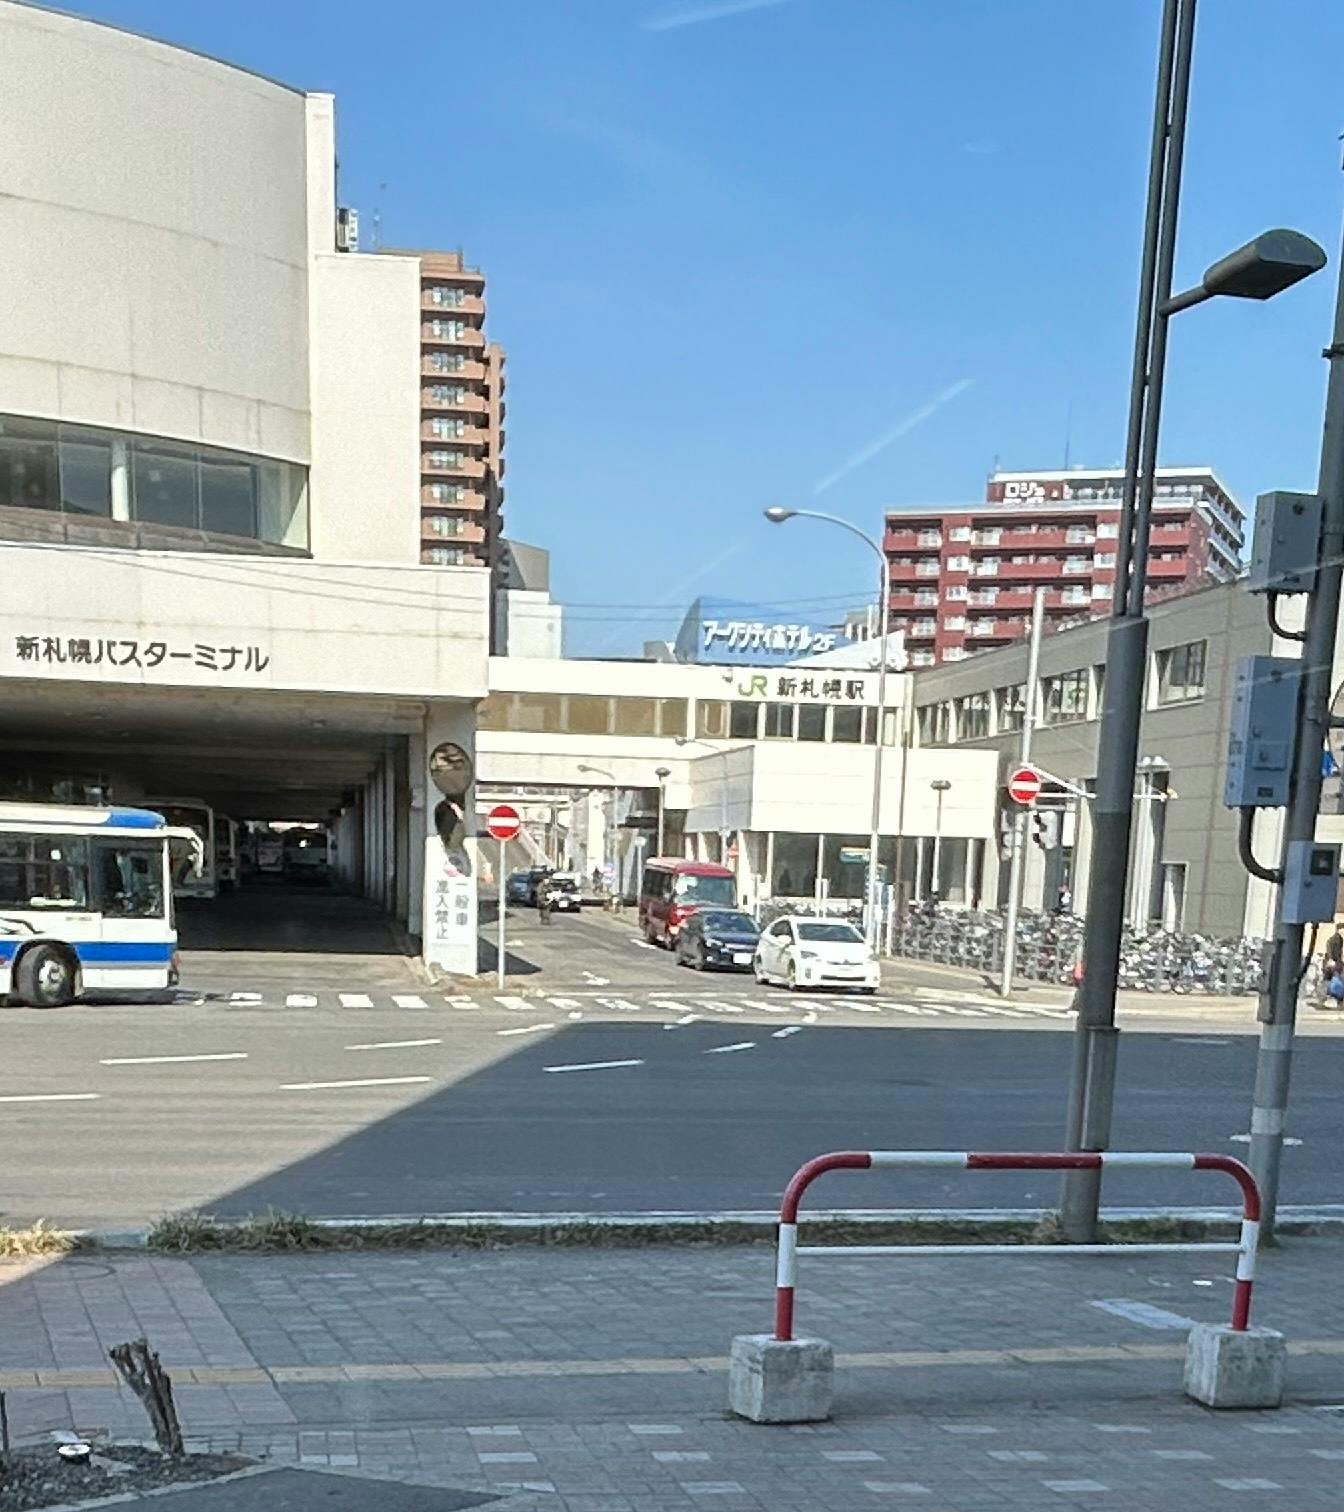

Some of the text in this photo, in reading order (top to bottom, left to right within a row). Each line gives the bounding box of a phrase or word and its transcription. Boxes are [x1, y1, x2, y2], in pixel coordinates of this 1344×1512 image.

[15, 635, 270, 672] 新札幌バスターミナル
[738, 675, 865, 700] JR 新札幌駅
